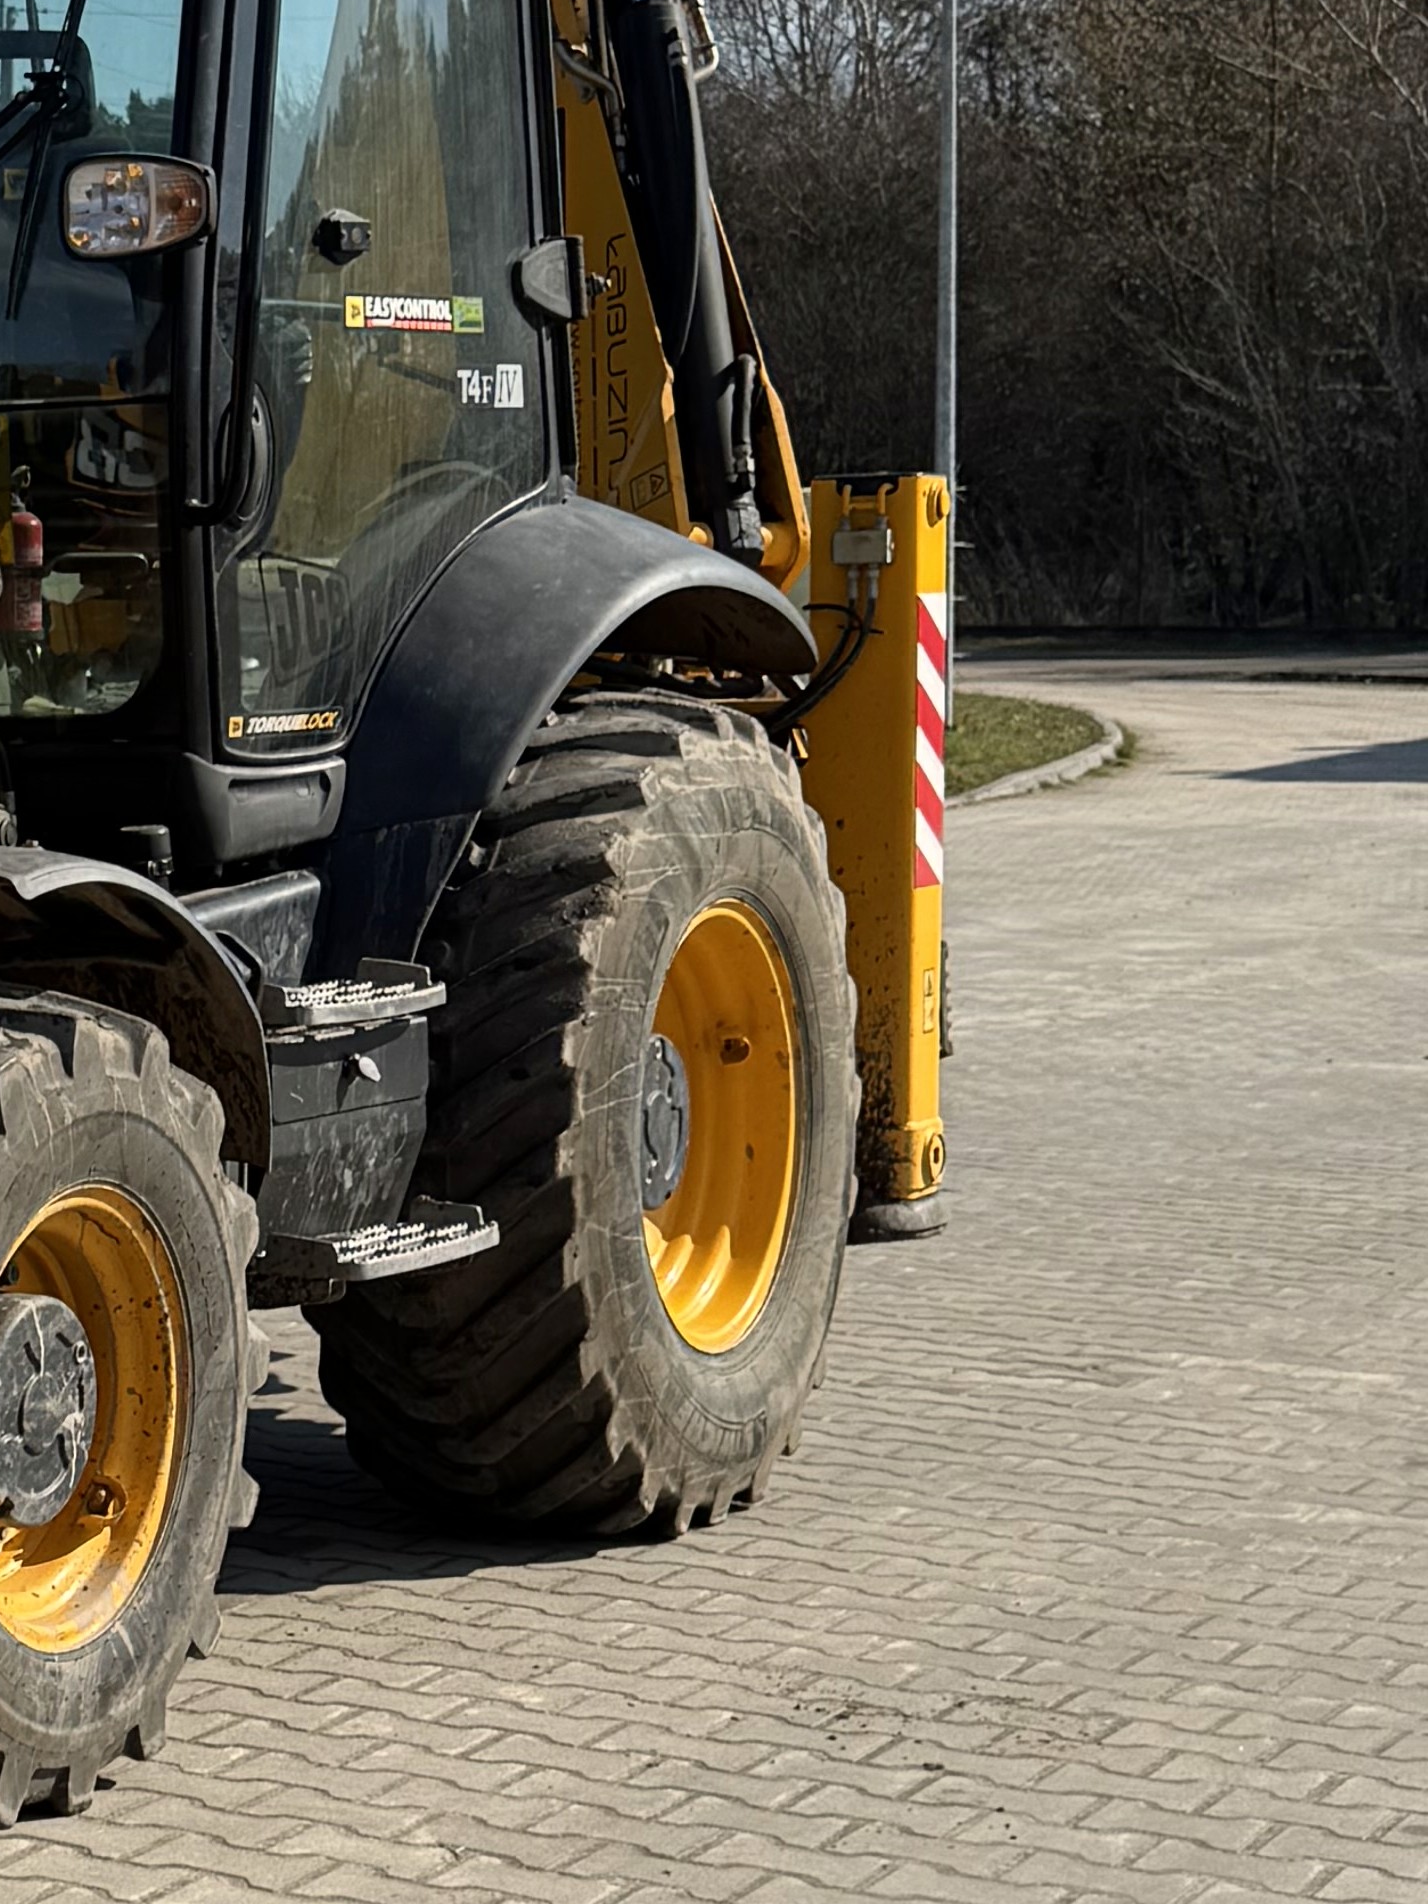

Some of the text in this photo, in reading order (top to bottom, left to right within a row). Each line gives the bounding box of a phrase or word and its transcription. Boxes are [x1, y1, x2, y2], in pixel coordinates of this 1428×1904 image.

[365, 296, 453, 327] EASYCONTROL
[456, 368, 519, 404] T4F IV
[246, 711, 339, 734] TORQUELOCK
